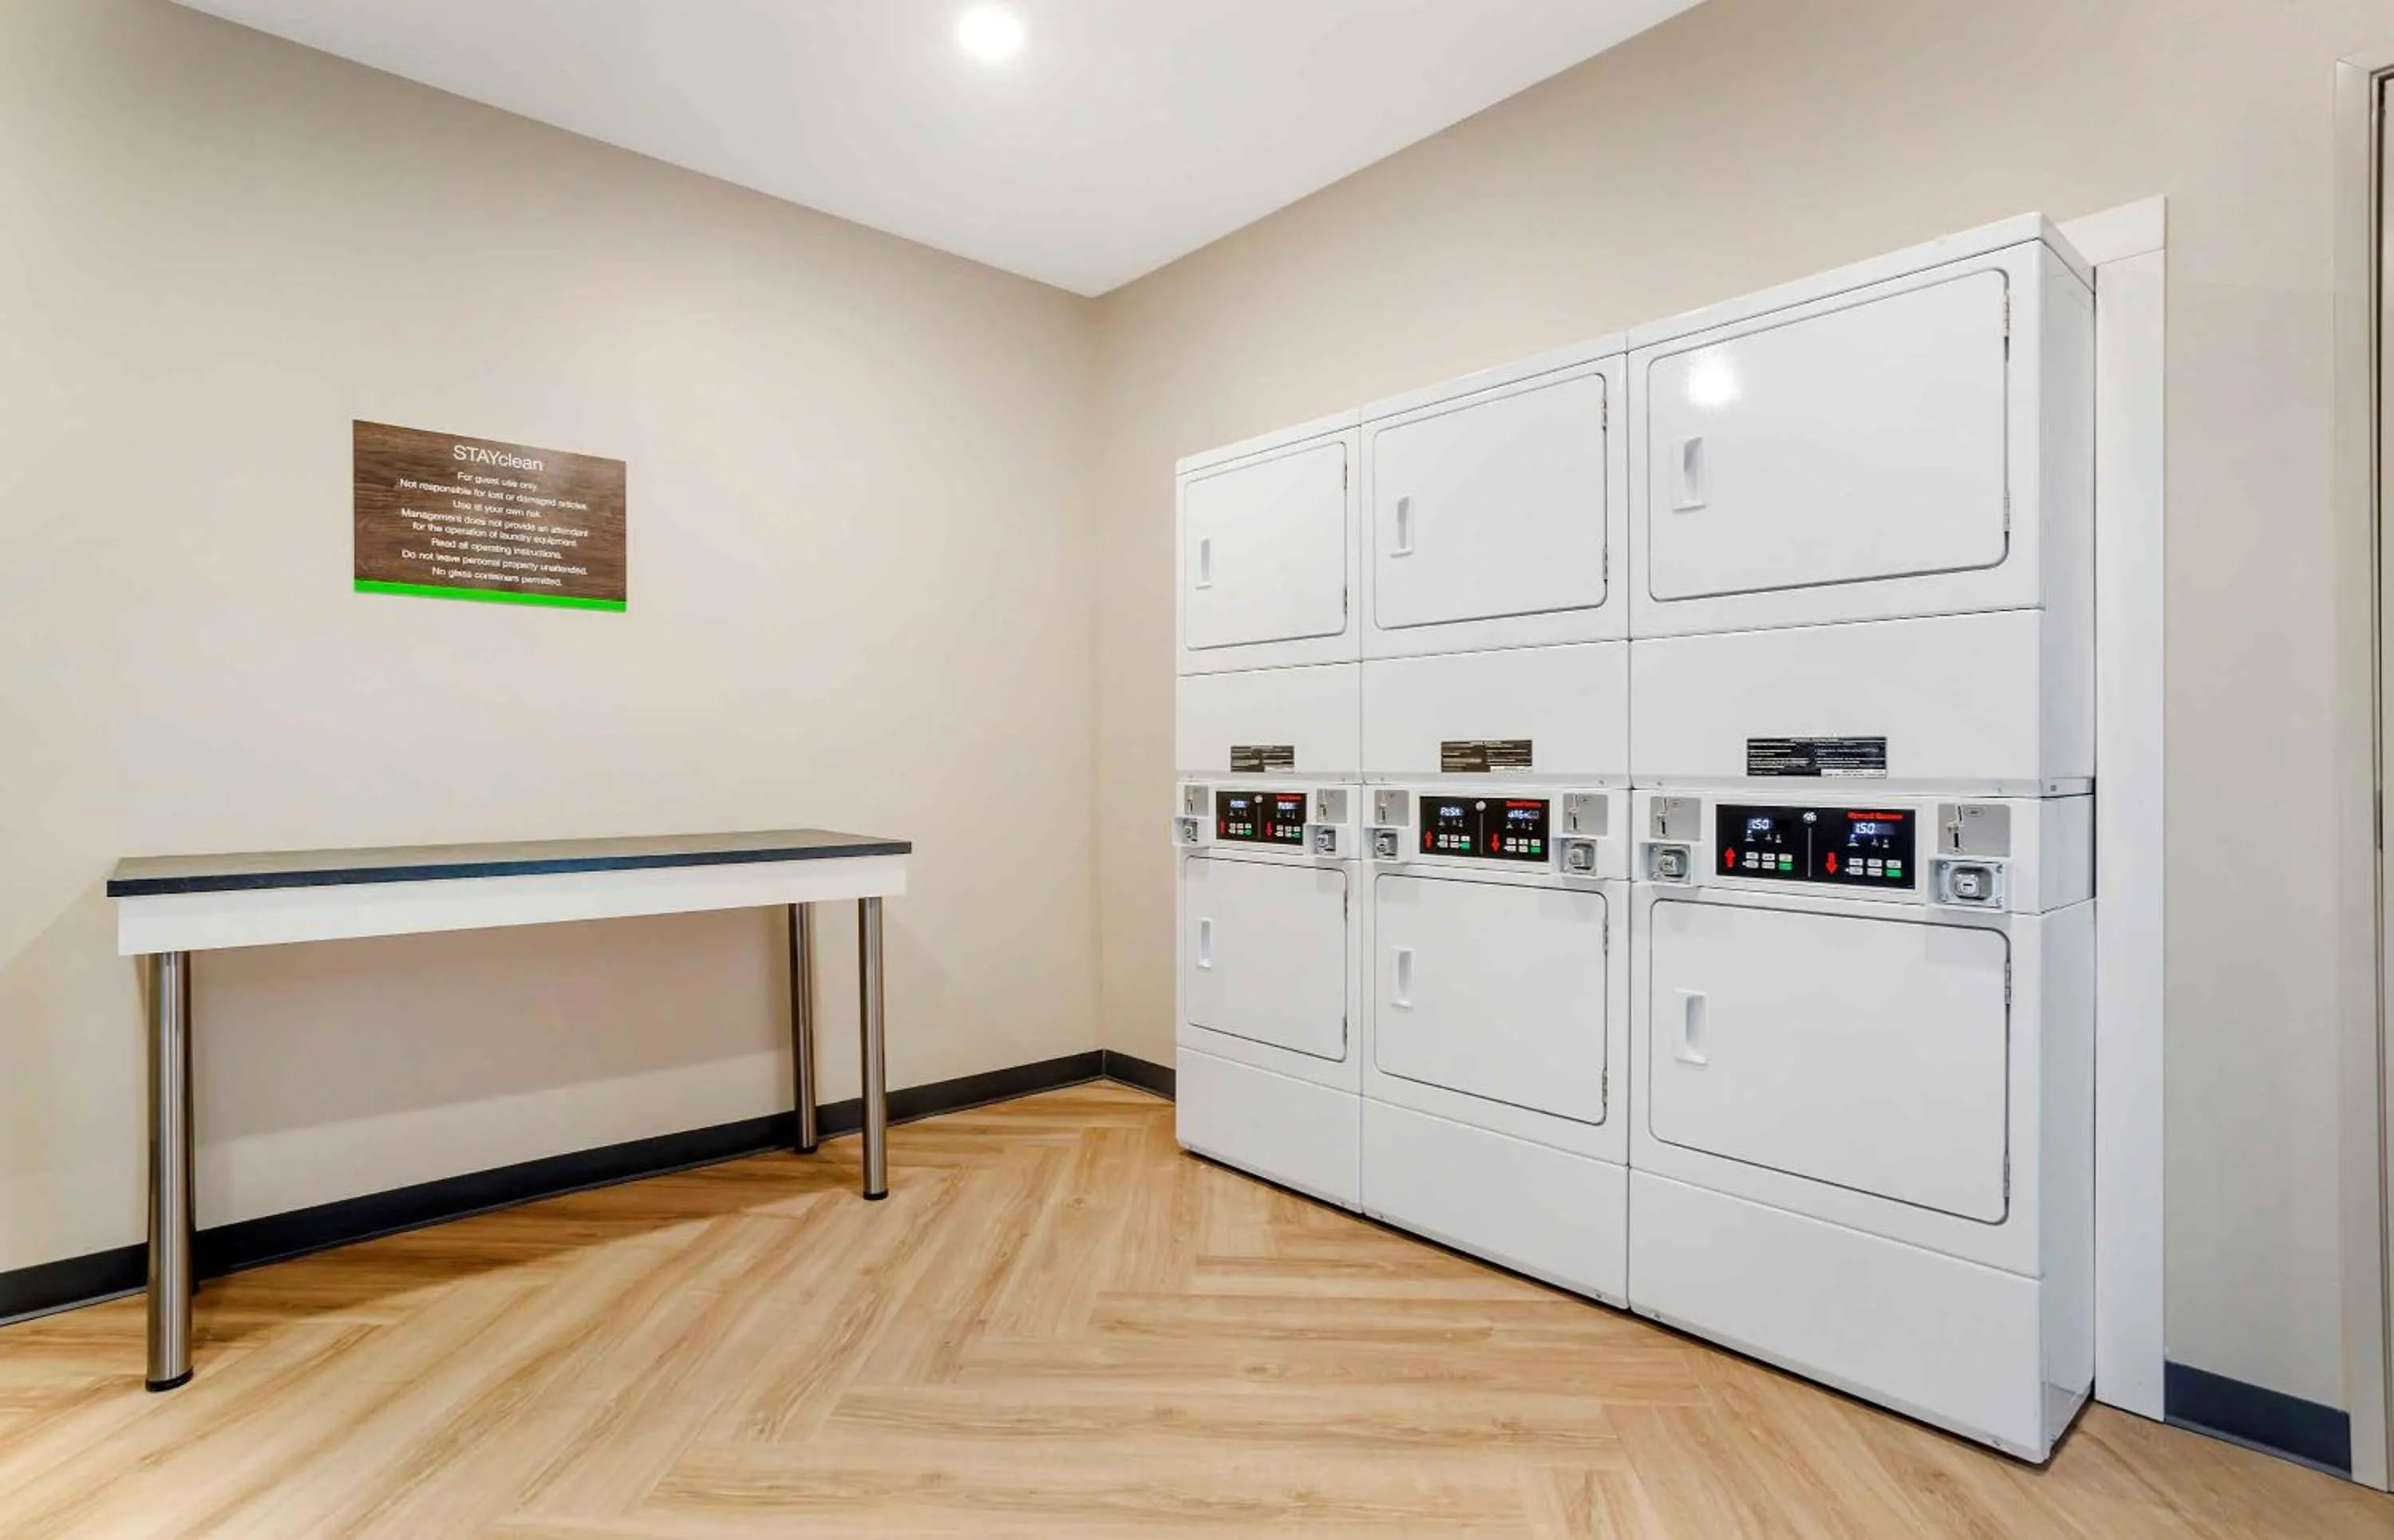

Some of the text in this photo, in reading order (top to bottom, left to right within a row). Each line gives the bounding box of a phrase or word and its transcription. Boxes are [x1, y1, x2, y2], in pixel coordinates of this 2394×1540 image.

[452, 444, 543, 472] STAYclean
[457, 472, 473, 482] For
[400, 478, 417, 489] Not
[419, 482, 472, 496] responsible
[473, 488, 486, 497] for
[488, 490, 504, 500] lost
[516, 494, 556, 507] damaged
[452, 499, 472, 510] Use
[484, 505, 504, 514] your
[505, 507, 524, 516] own
[401, 507, 462, 523] Management
[464, 516, 486, 527] does
[488, 519, 503, 528] not
[504, 522, 536, 533] provide
[550, 527, 588, 538] attendant
[413, 521, 426, 531] for
[427, 523, 443, 533] the
[444, 526, 488, 538] operation
[489, 530, 499, 539] of
[499, 531, 531, 543] laundry
[432, 537, 456, 548] Read
[470, 543, 512, 556] operating
[401, 548, 417, 559] Do
[418, 551, 434, 561] not
[434, 552, 460, 563] leave
[462, 555, 502, 568] personal
[502, 560, 539, 573] property
[432, 566, 446, 575] No
